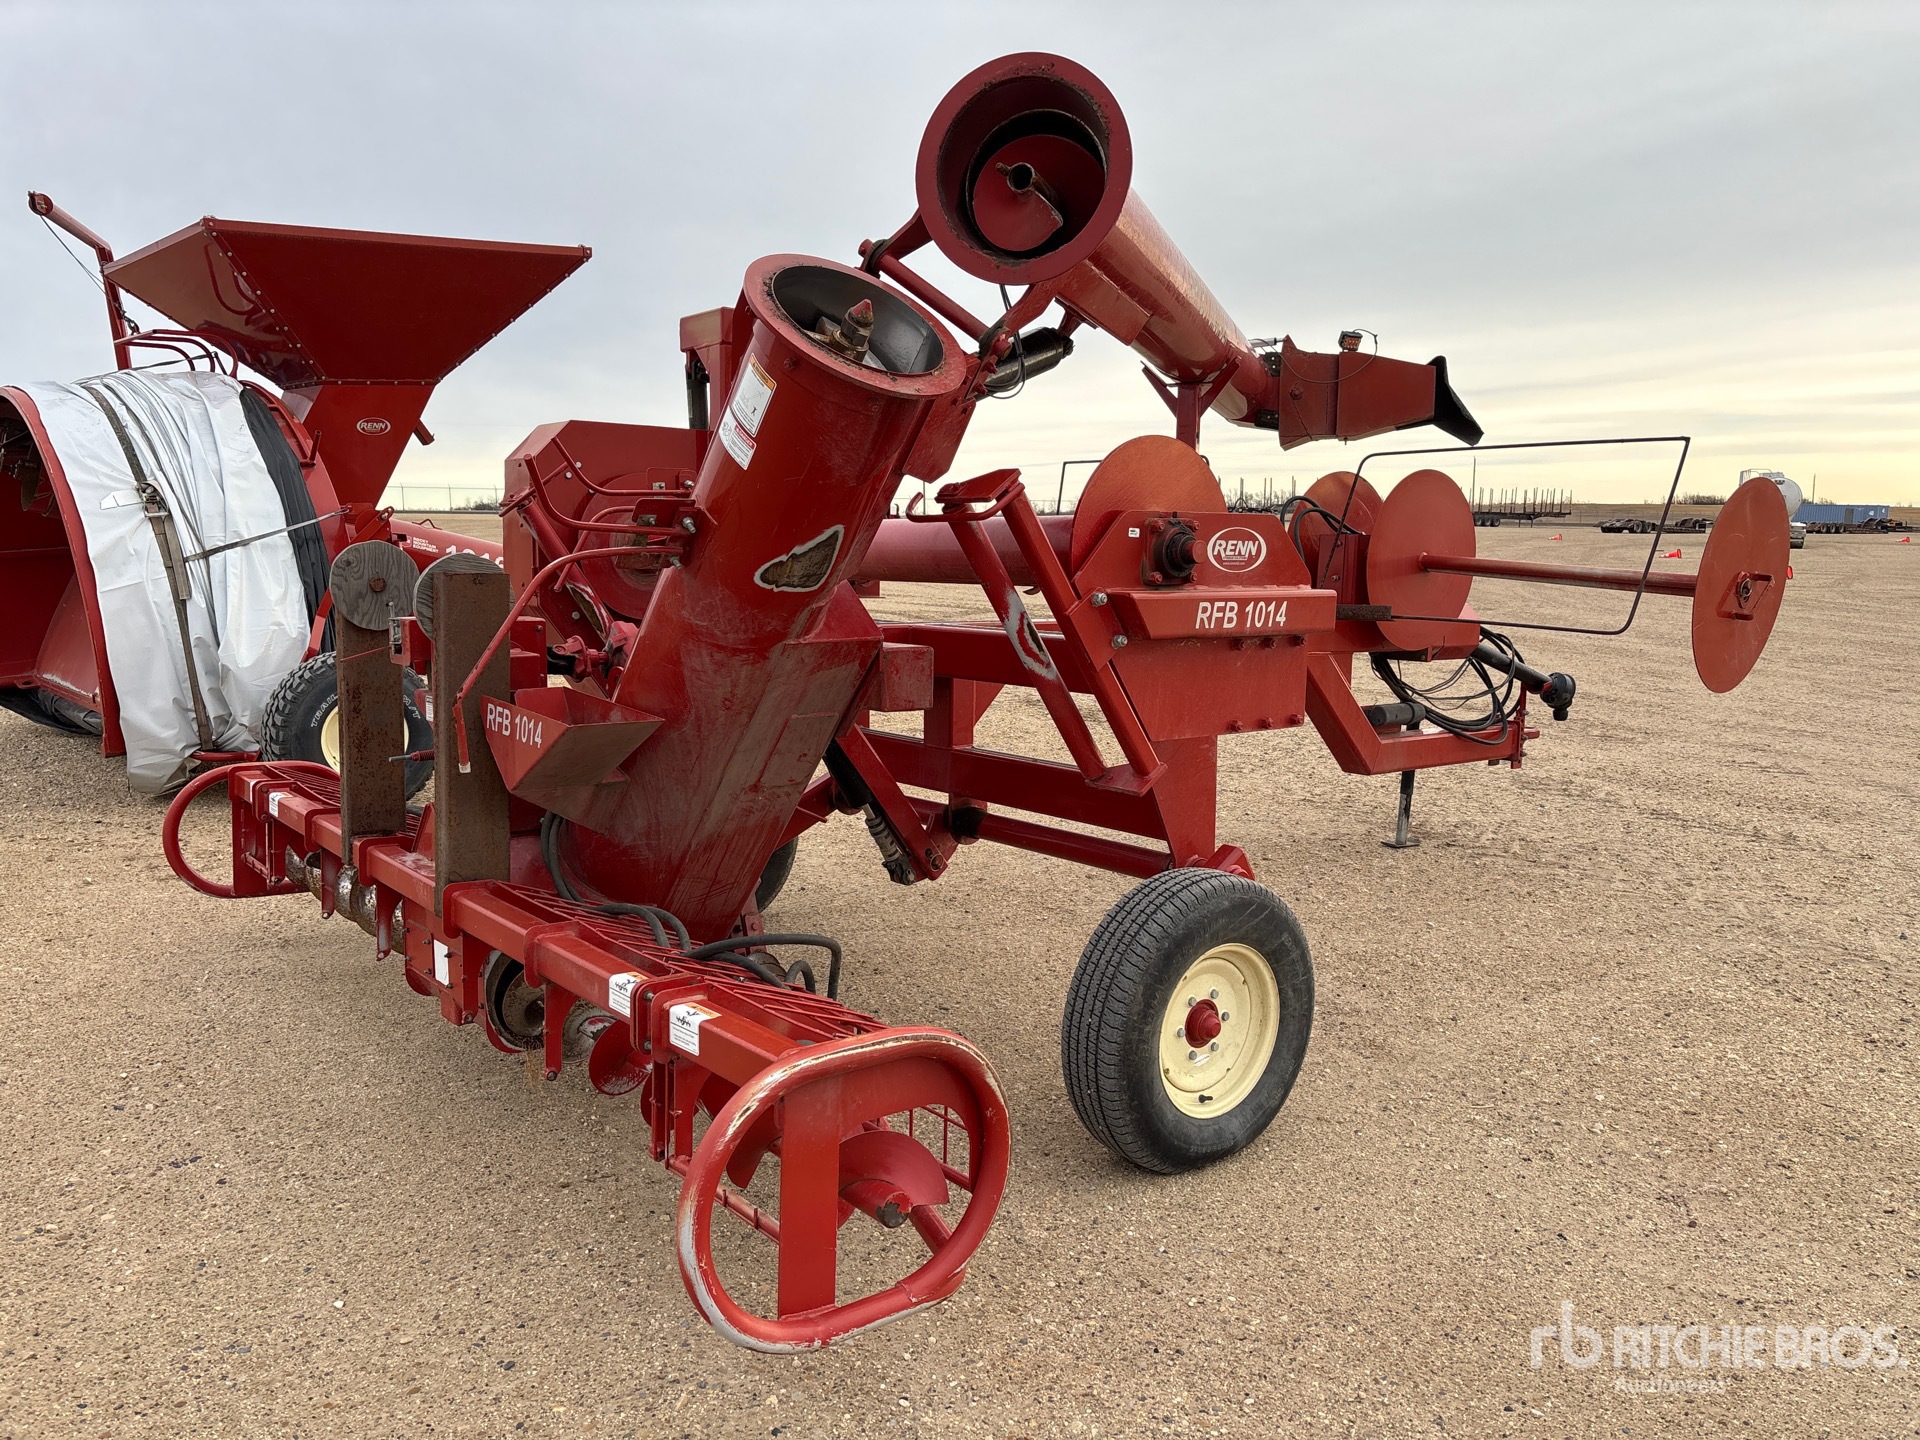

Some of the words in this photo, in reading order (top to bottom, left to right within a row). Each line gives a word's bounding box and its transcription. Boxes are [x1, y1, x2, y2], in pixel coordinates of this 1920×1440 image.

[360, 422, 386, 430] RENN
[1213, 540, 1259, 557] RENN
[1195, 601, 1239, 629] RFB
[1245, 600, 1288, 628] 1014
[486, 703, 511, 736] RFB
[514, 713, 543, 749] 1014
